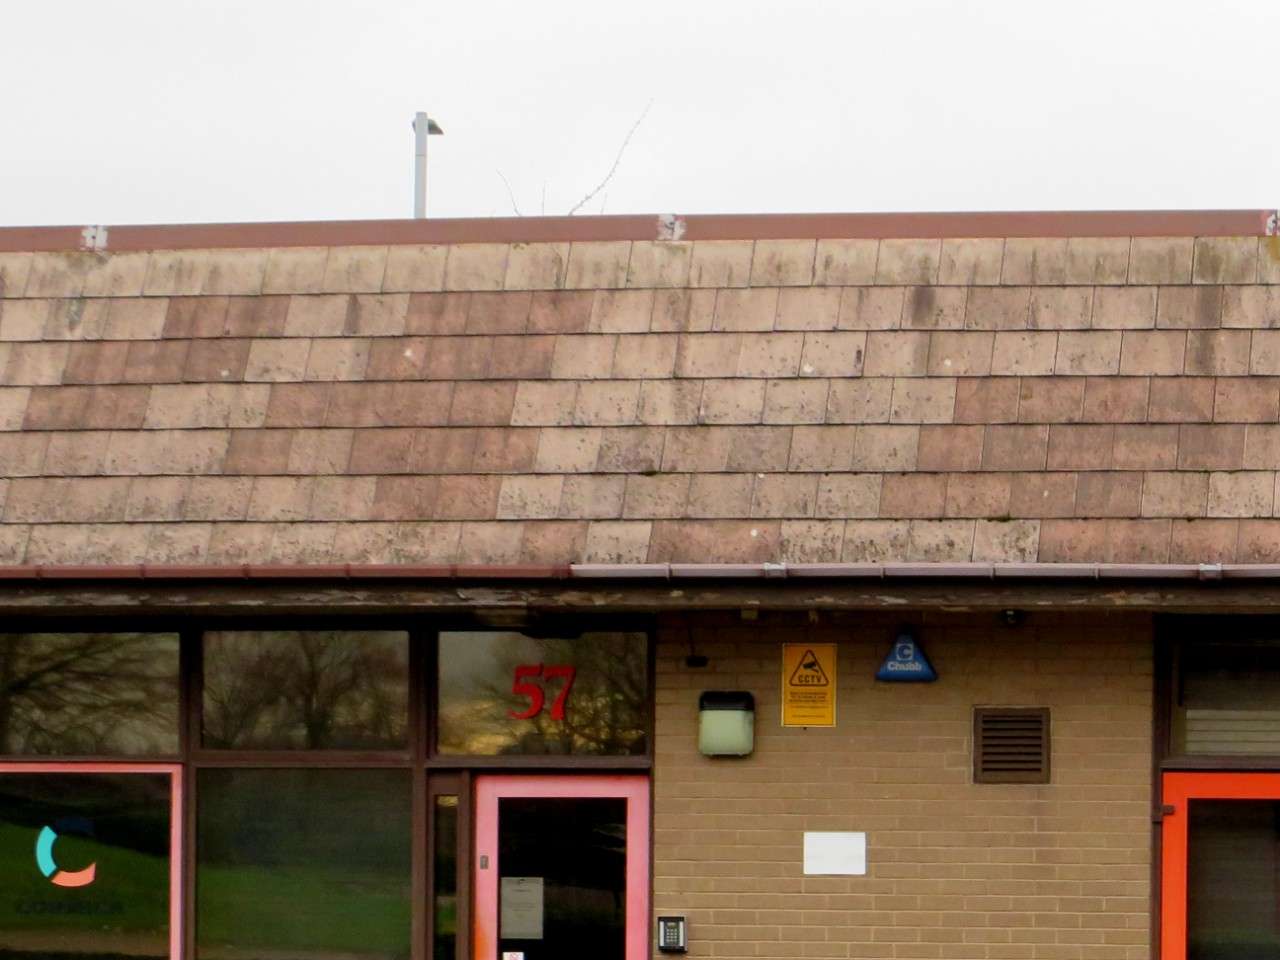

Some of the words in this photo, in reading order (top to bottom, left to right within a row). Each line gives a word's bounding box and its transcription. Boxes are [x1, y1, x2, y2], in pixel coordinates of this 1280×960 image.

[887, 661, 922, 671] Chubb
[798, 675, 822, 684] CCTV
[507, 662, 576, 720] 57
